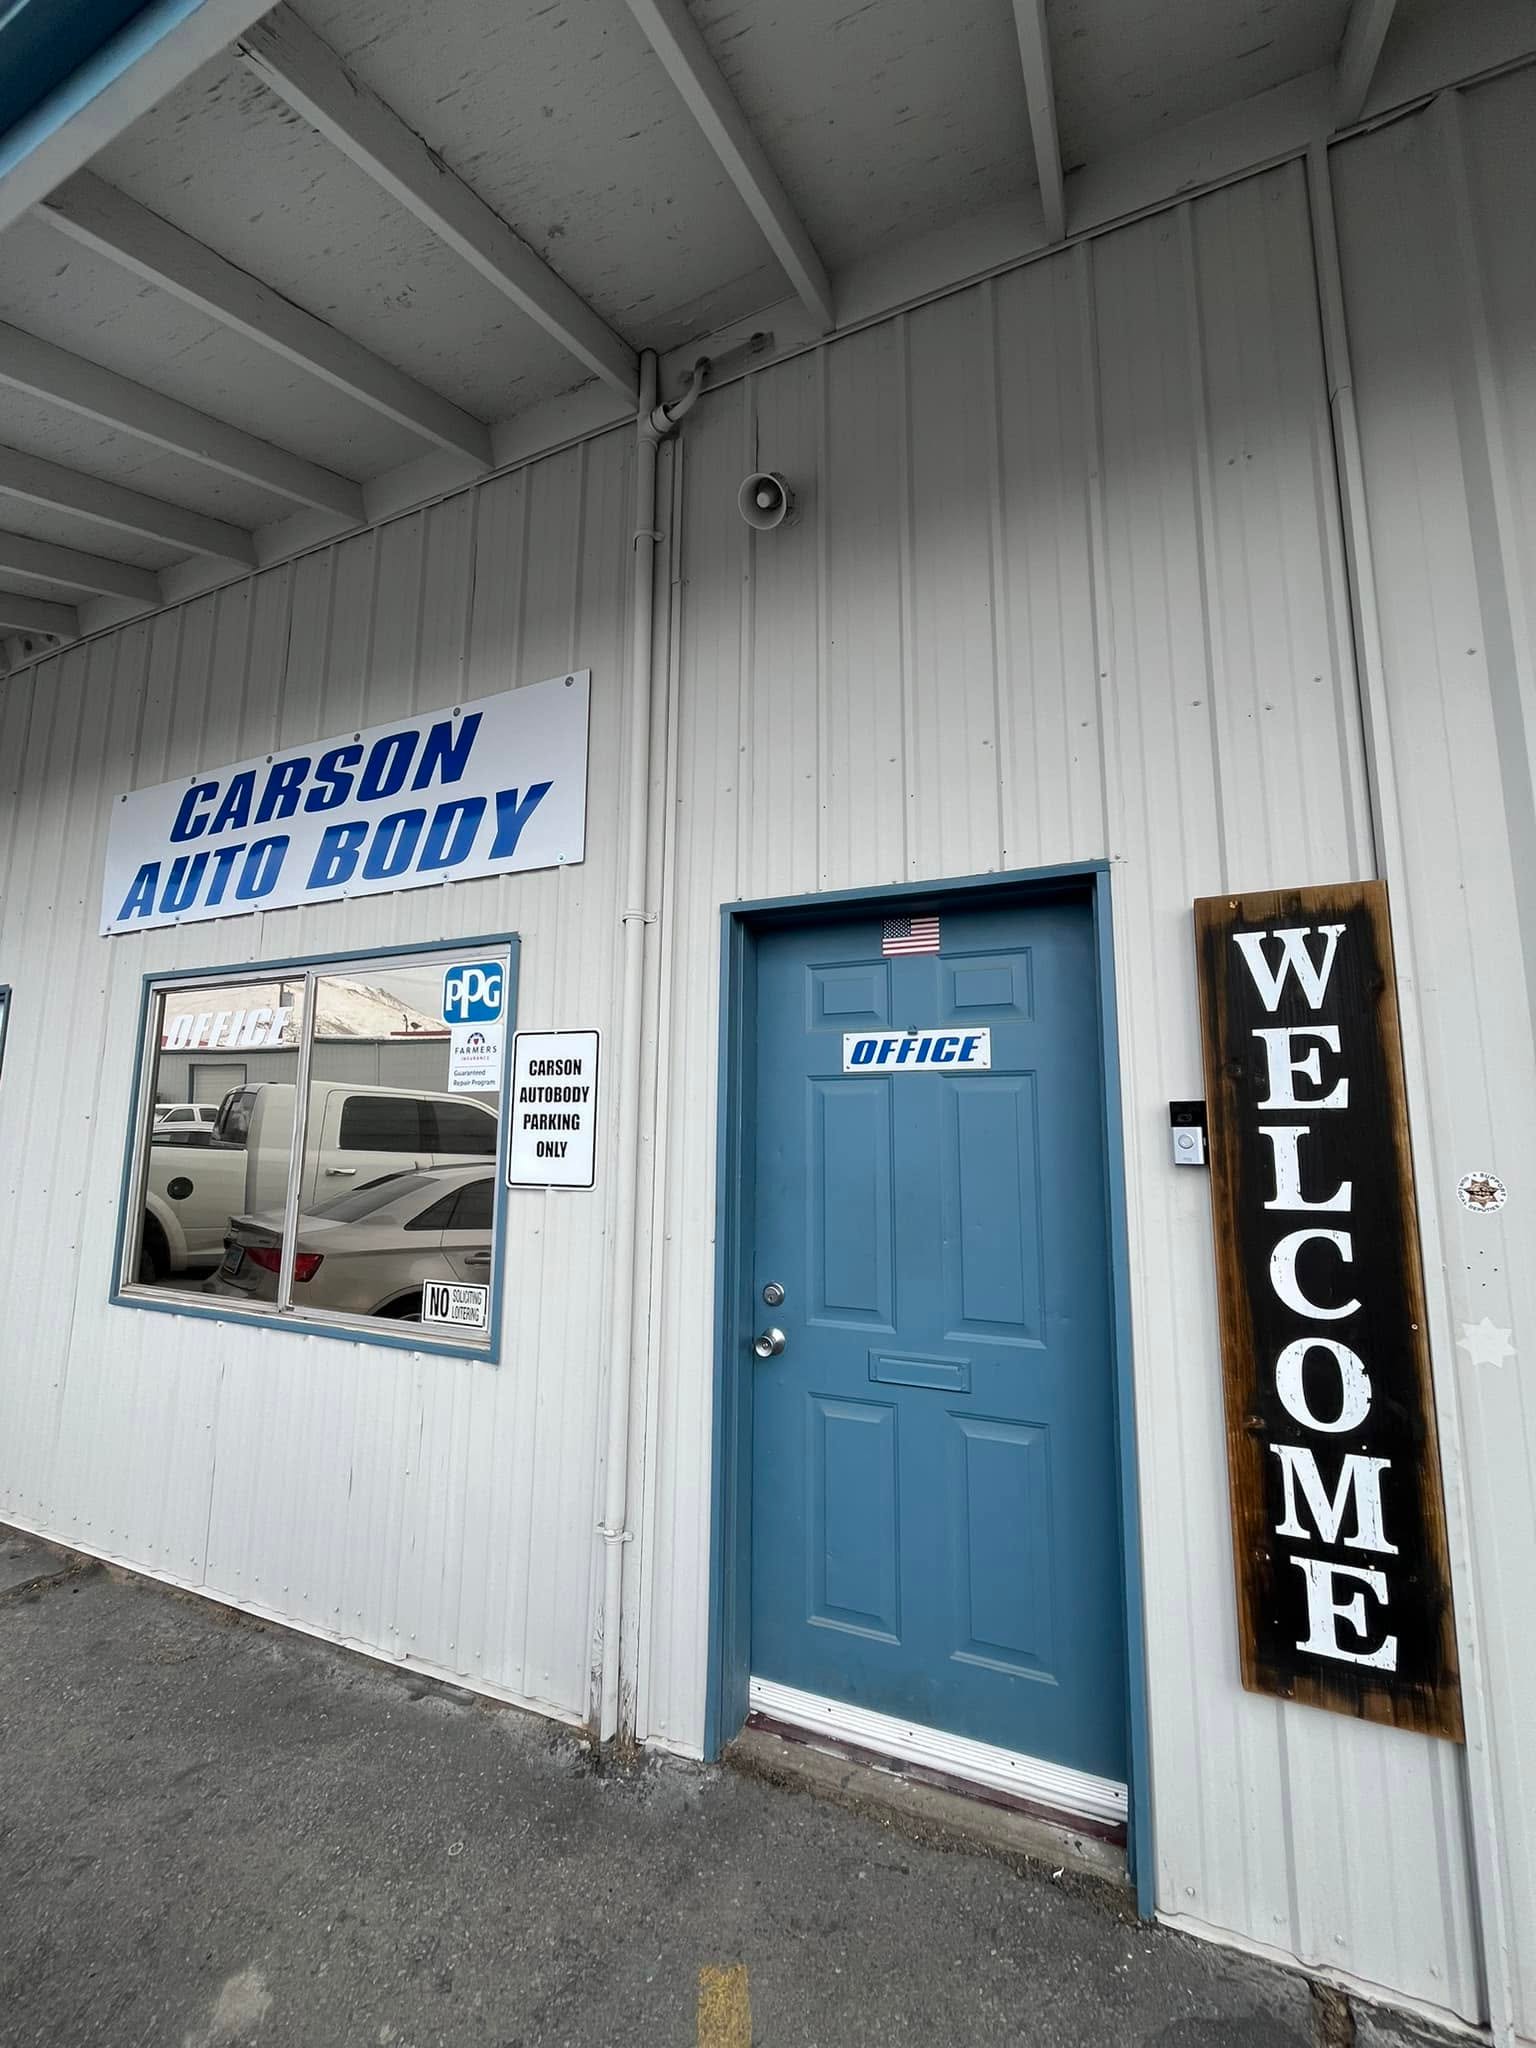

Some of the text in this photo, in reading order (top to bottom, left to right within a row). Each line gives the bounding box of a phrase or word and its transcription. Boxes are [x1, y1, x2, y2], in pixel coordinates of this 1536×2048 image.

[170, 712, 483, 843] CARSON
[116, 780, 554, 921] AUTO BODY
[445, 968, 501, 1019] PPG
[166, 1006, 294, 1048] OFFICE
[454, 1045, 497, 1055] FARMERS
[850, 1036, 982, 1065] OFFICE
[453, 1069, 486, 1077] Guaranteed
[529, 1059, 582, 1077] CARSON
[453, 1079, 496, 1087] Repair Program
[519, 1086, 590, 1104] AUTOBODY
[523, 1113, 581, 1131] PARKING
[536, 1140, 568, 1158] ONLY
[430, 1287, 449, 1317] NO
[1233, 923, 1399, 1672] WELCOME
